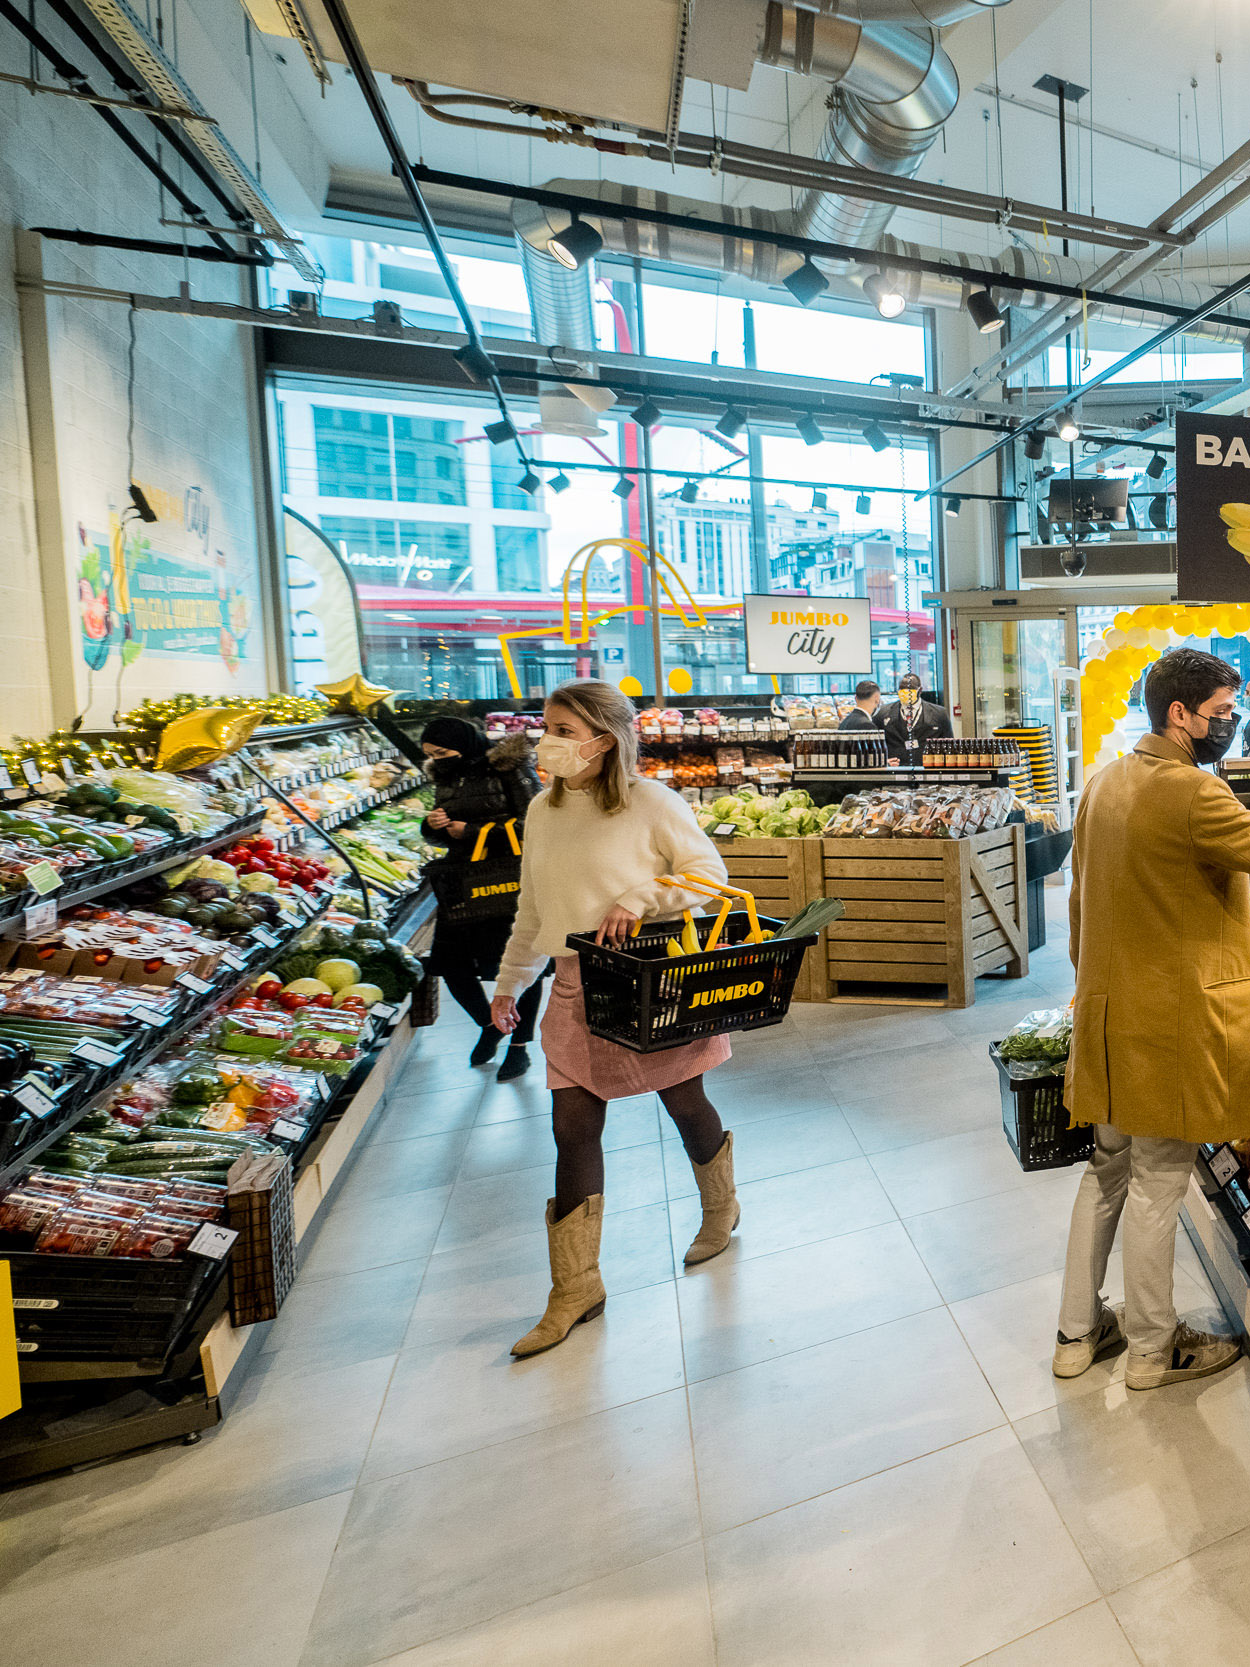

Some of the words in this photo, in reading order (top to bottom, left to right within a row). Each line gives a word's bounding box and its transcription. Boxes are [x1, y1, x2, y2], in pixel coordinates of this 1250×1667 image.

[768, 611, 849, 627] JUMBO
[787, 628, 835, 664] city
[470, 882, 520, 899] JUMB
[689, 980, 765, 1009] JUMBO
